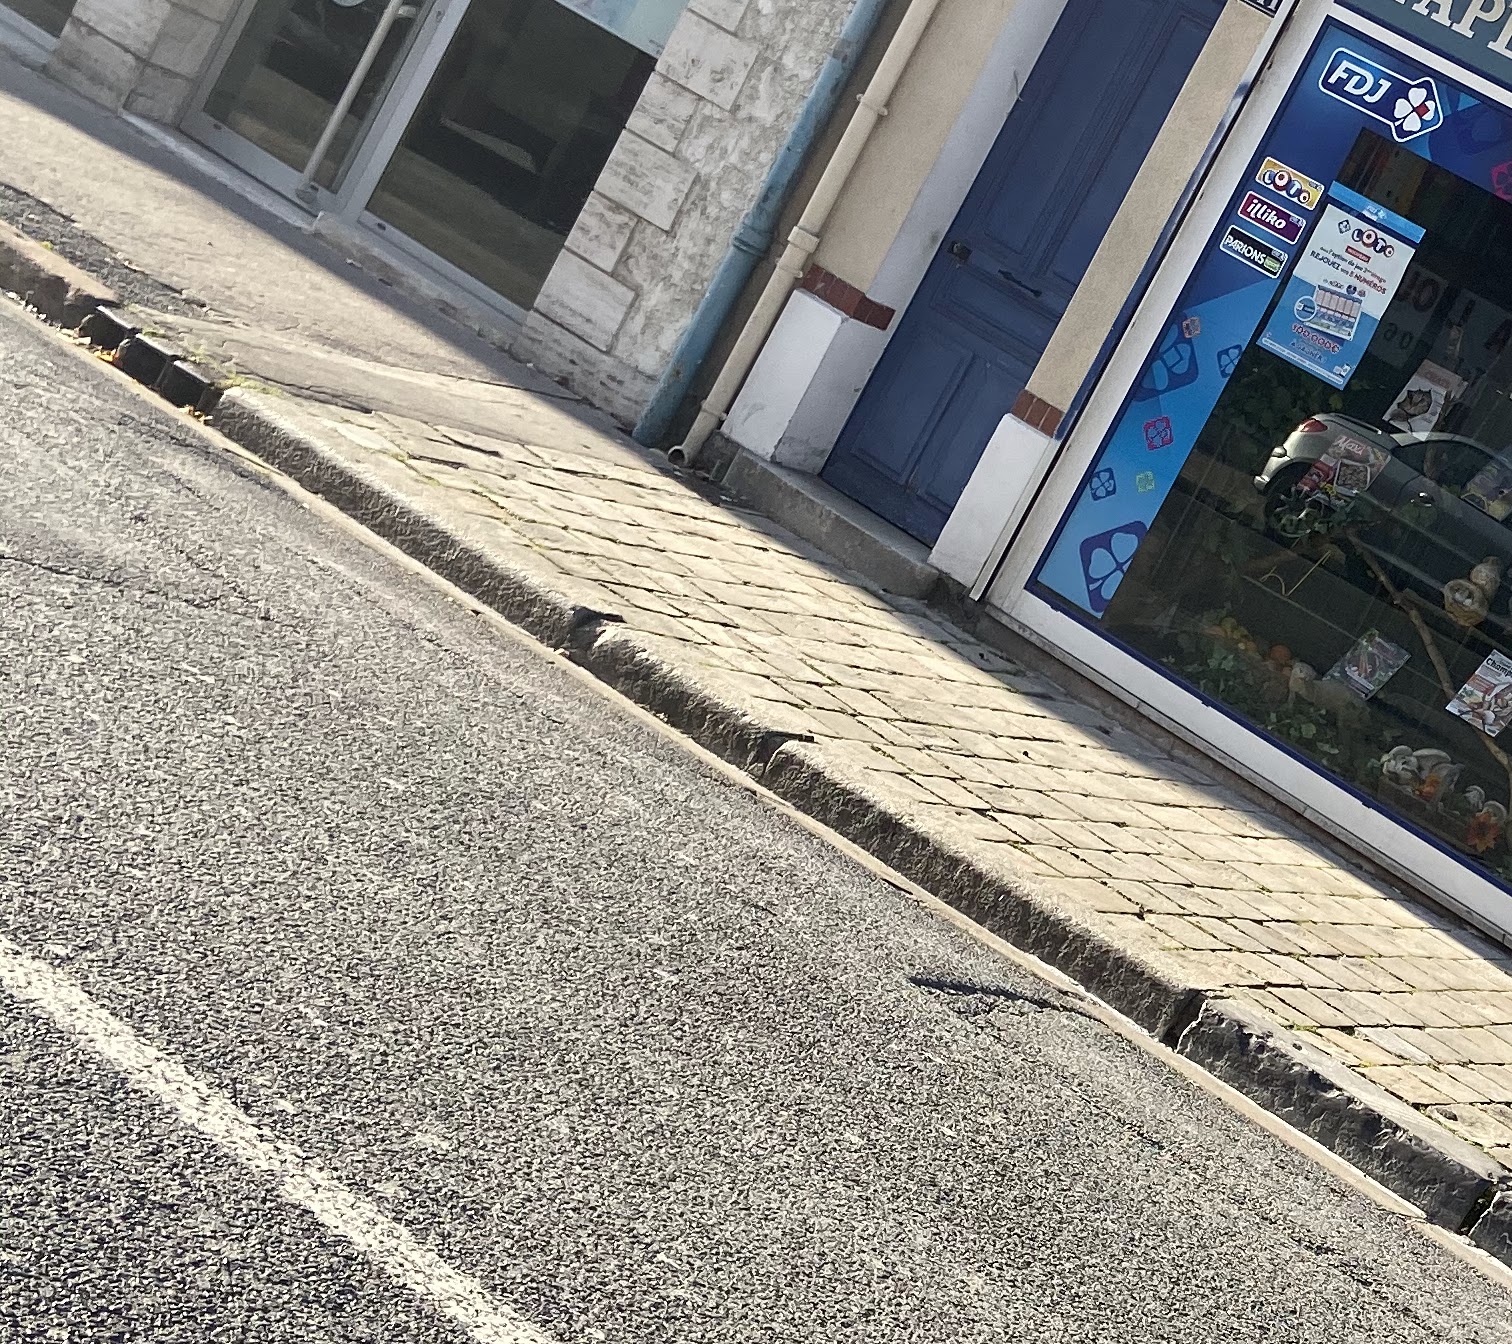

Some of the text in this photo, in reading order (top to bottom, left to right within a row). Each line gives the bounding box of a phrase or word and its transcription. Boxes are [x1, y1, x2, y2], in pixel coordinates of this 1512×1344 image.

[1327, 59, 1392, 104] FDJ
[1262, 169, 1311, 204] LOTO
[1246, 198, 1287, 230] illiko
[1223, 234, 1267, 265] PARIONS
[1351, 228, 1395, 258] LOTO
